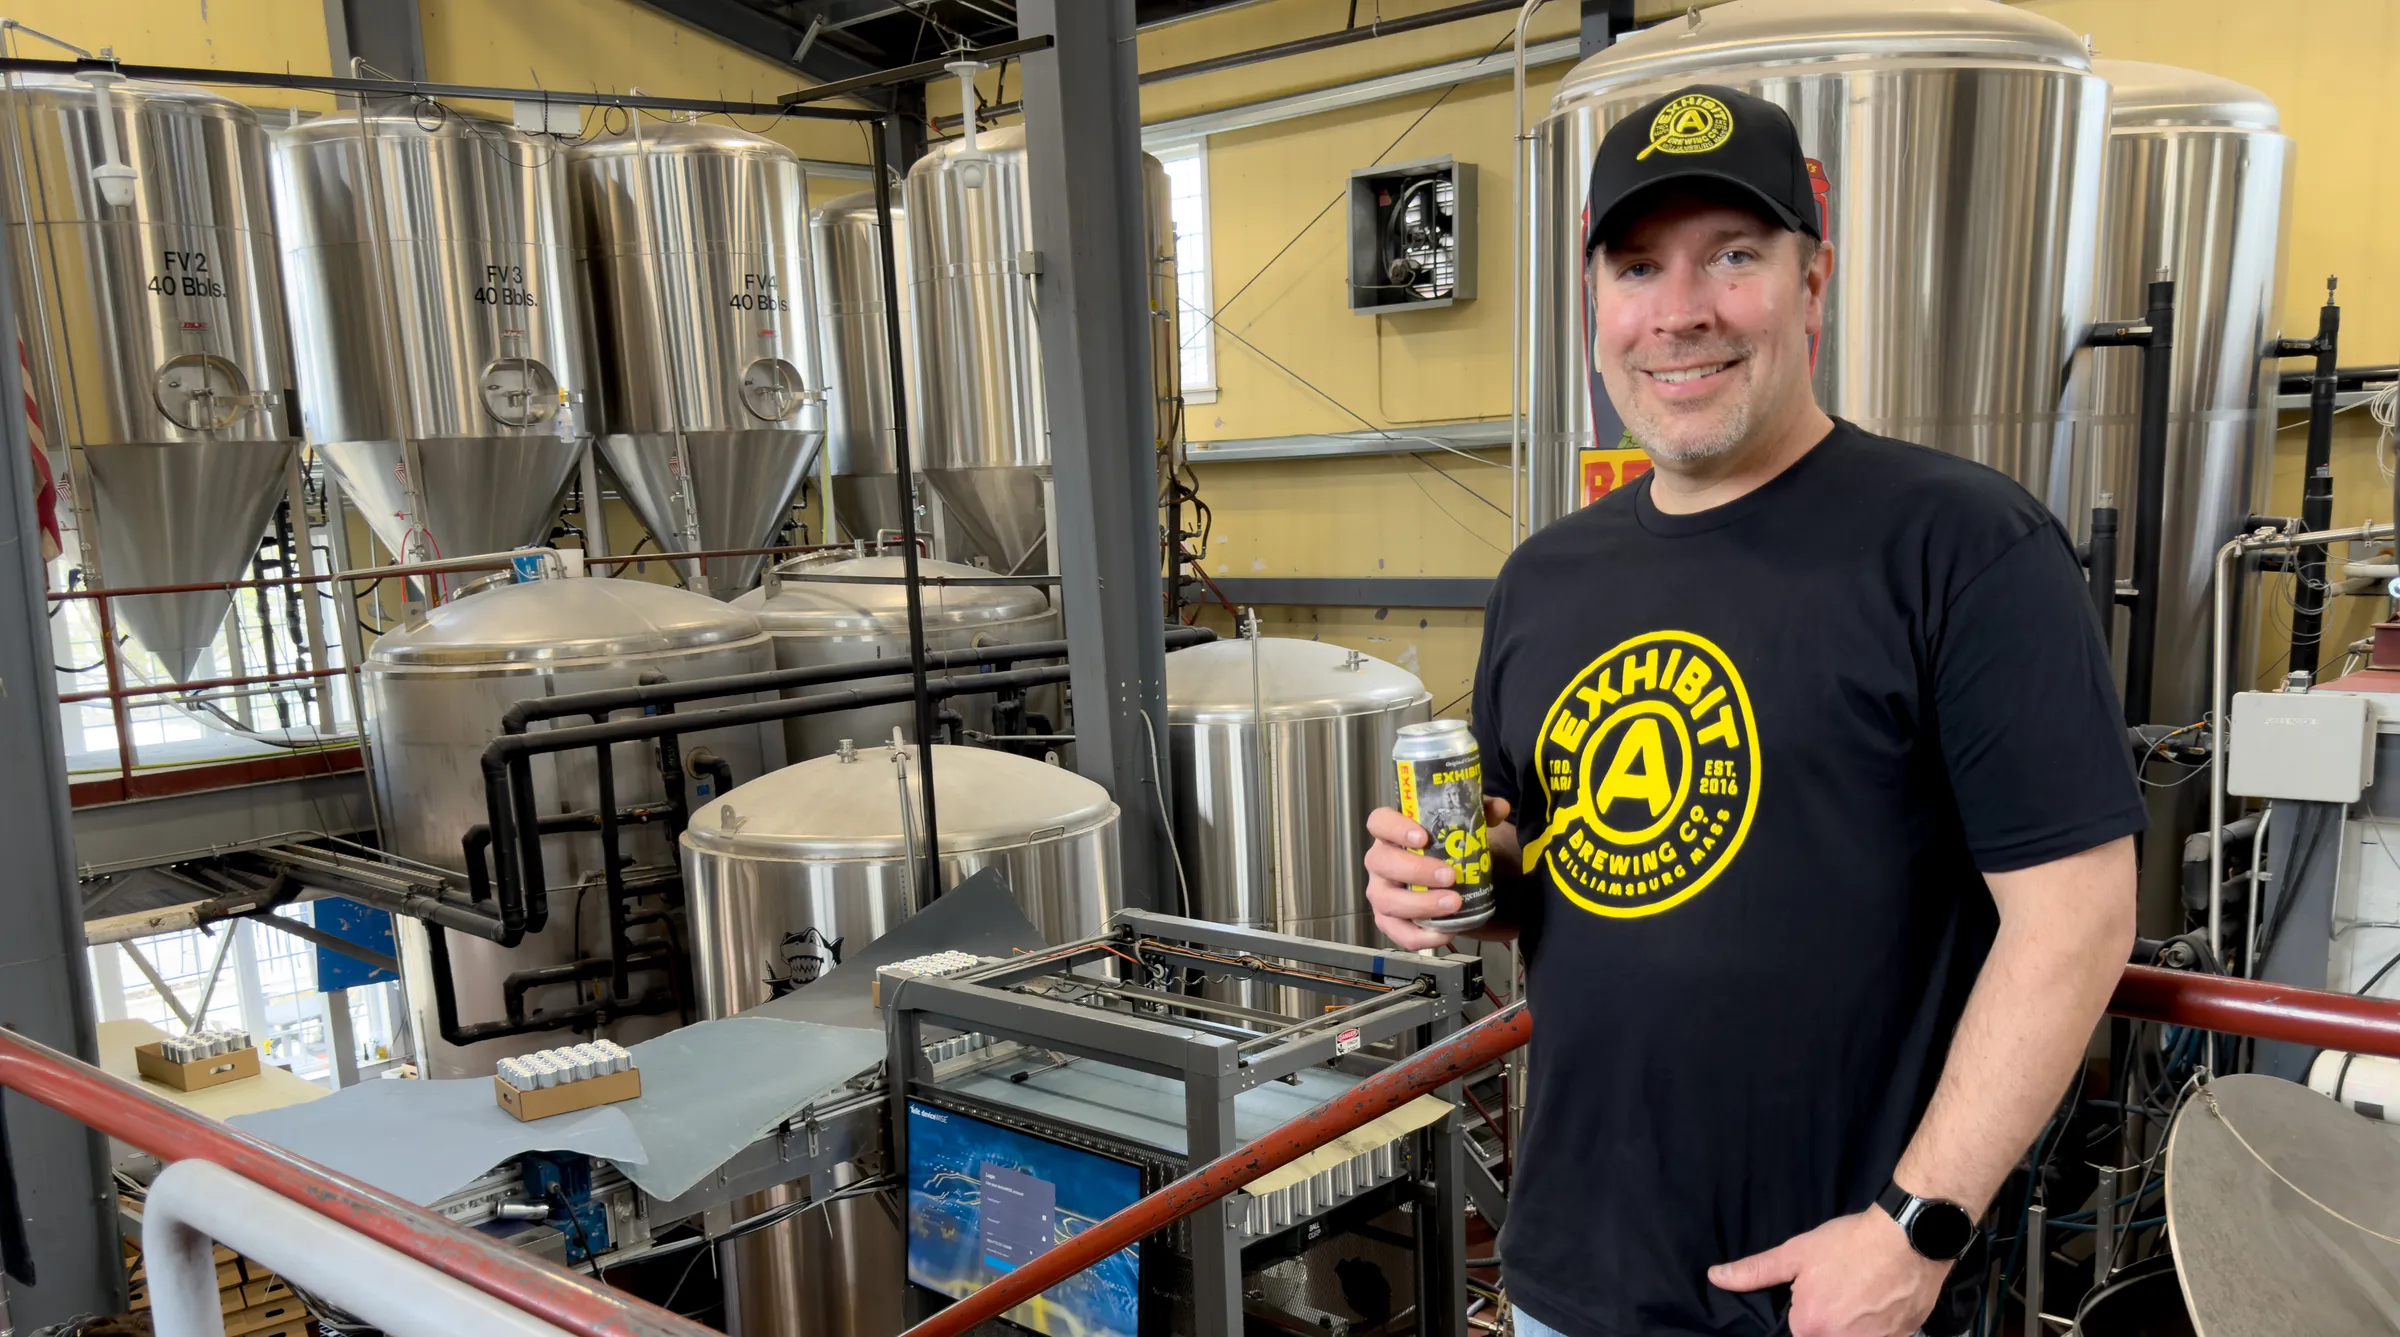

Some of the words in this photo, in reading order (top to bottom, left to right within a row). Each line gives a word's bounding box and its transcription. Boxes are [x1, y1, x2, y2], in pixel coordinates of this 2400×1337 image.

[1658, 97, 1727, 123] EXHIBIT
[1676, 110, 1706, 132] A
[164, 252, 190, 271] FV
[195, 252, 208, 272] 2
[487, 265, 508, 283] FV
[512, 266, 522, 284] 3
[148, 276, 176, 295] 40
[182, 277, 226, 297] Bbls.
[474, 287, 497, 305] 40
[502, 288, 538, 307] Bbls.
[730, 294, 753, 310] 40
[757, 294, 790, 312] Bbls.
[1550, 648, 1740, 753] EXHIBIT
[1596, 718, 1672, 817] A
[1704, 760, 1737, 777] EST.
[1699, 777, 1738, 796] 2016
[1558, 846, 1686, 897] WILLIAMSBURG
[1690, 809, 1731, 866] MASS
[1568, 828, 1677, 876] BREWING
[1461, 887, 1490, 903] egendary
